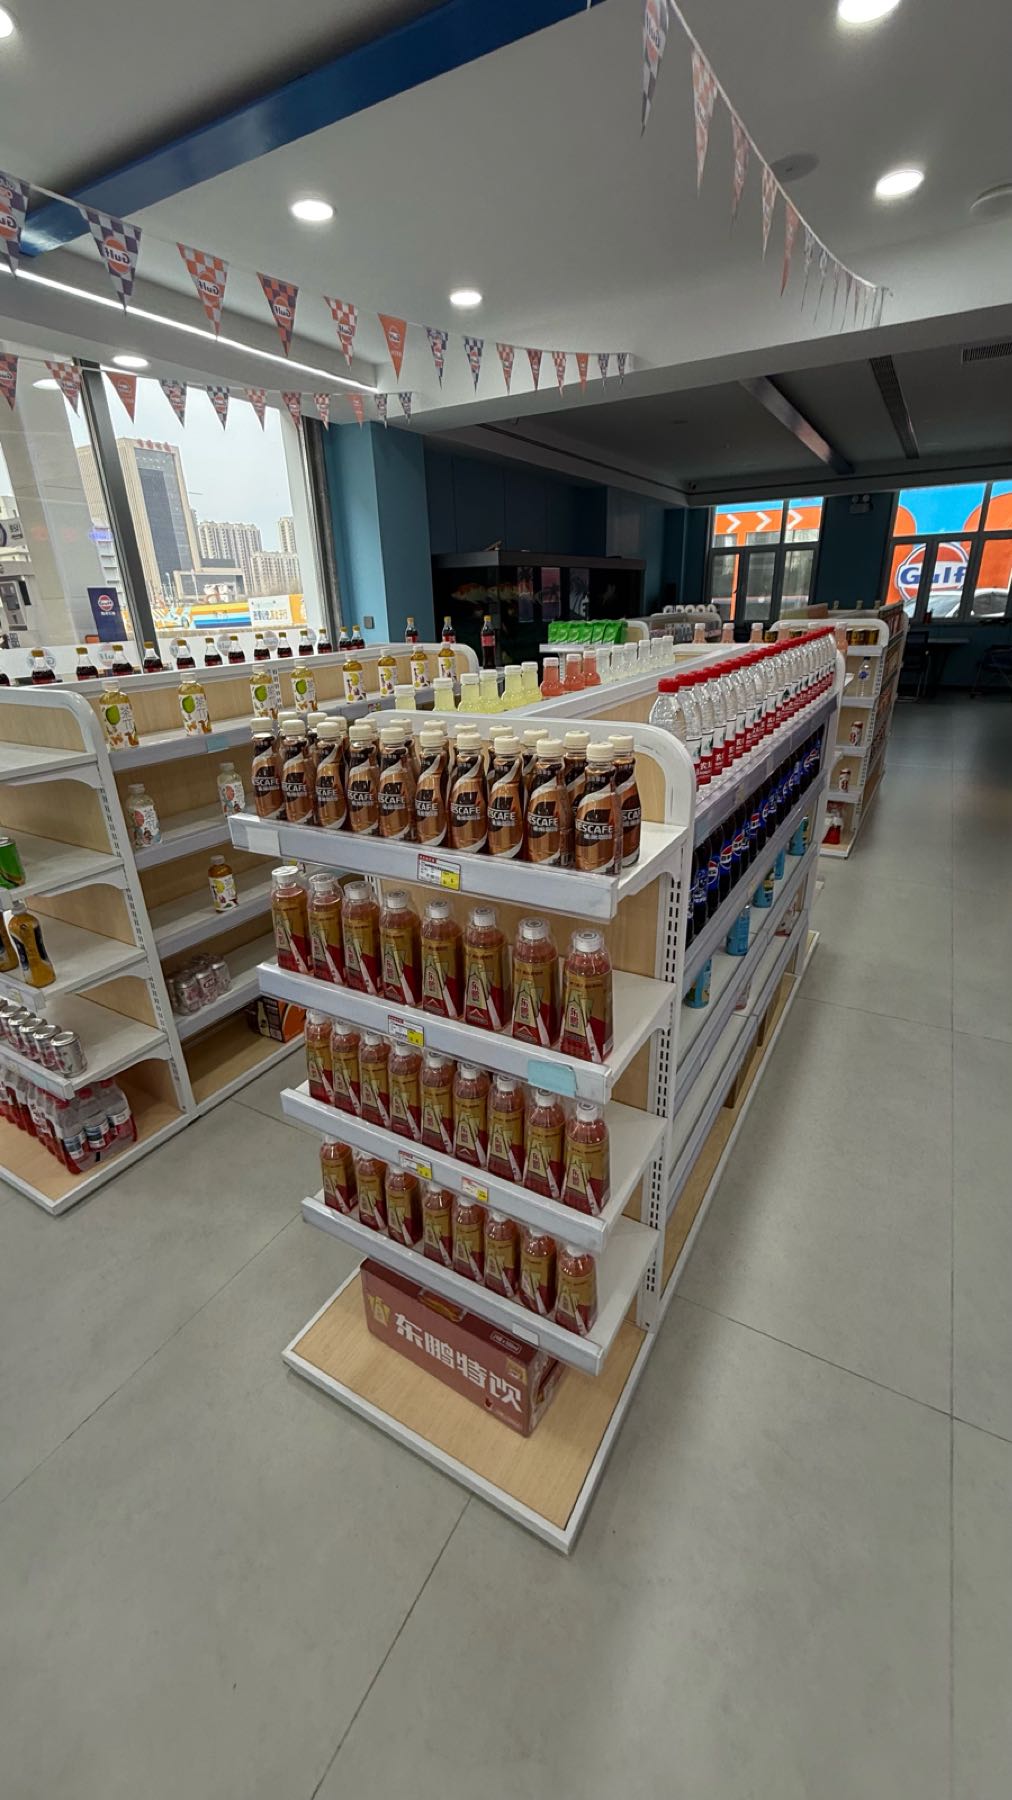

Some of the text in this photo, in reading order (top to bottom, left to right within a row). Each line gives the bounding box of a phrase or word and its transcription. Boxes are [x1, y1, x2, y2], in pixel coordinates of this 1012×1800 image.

[575, 821, 614, 835] ESCAFE
[394, 1312, 522, 1413] 东鹏特饮
